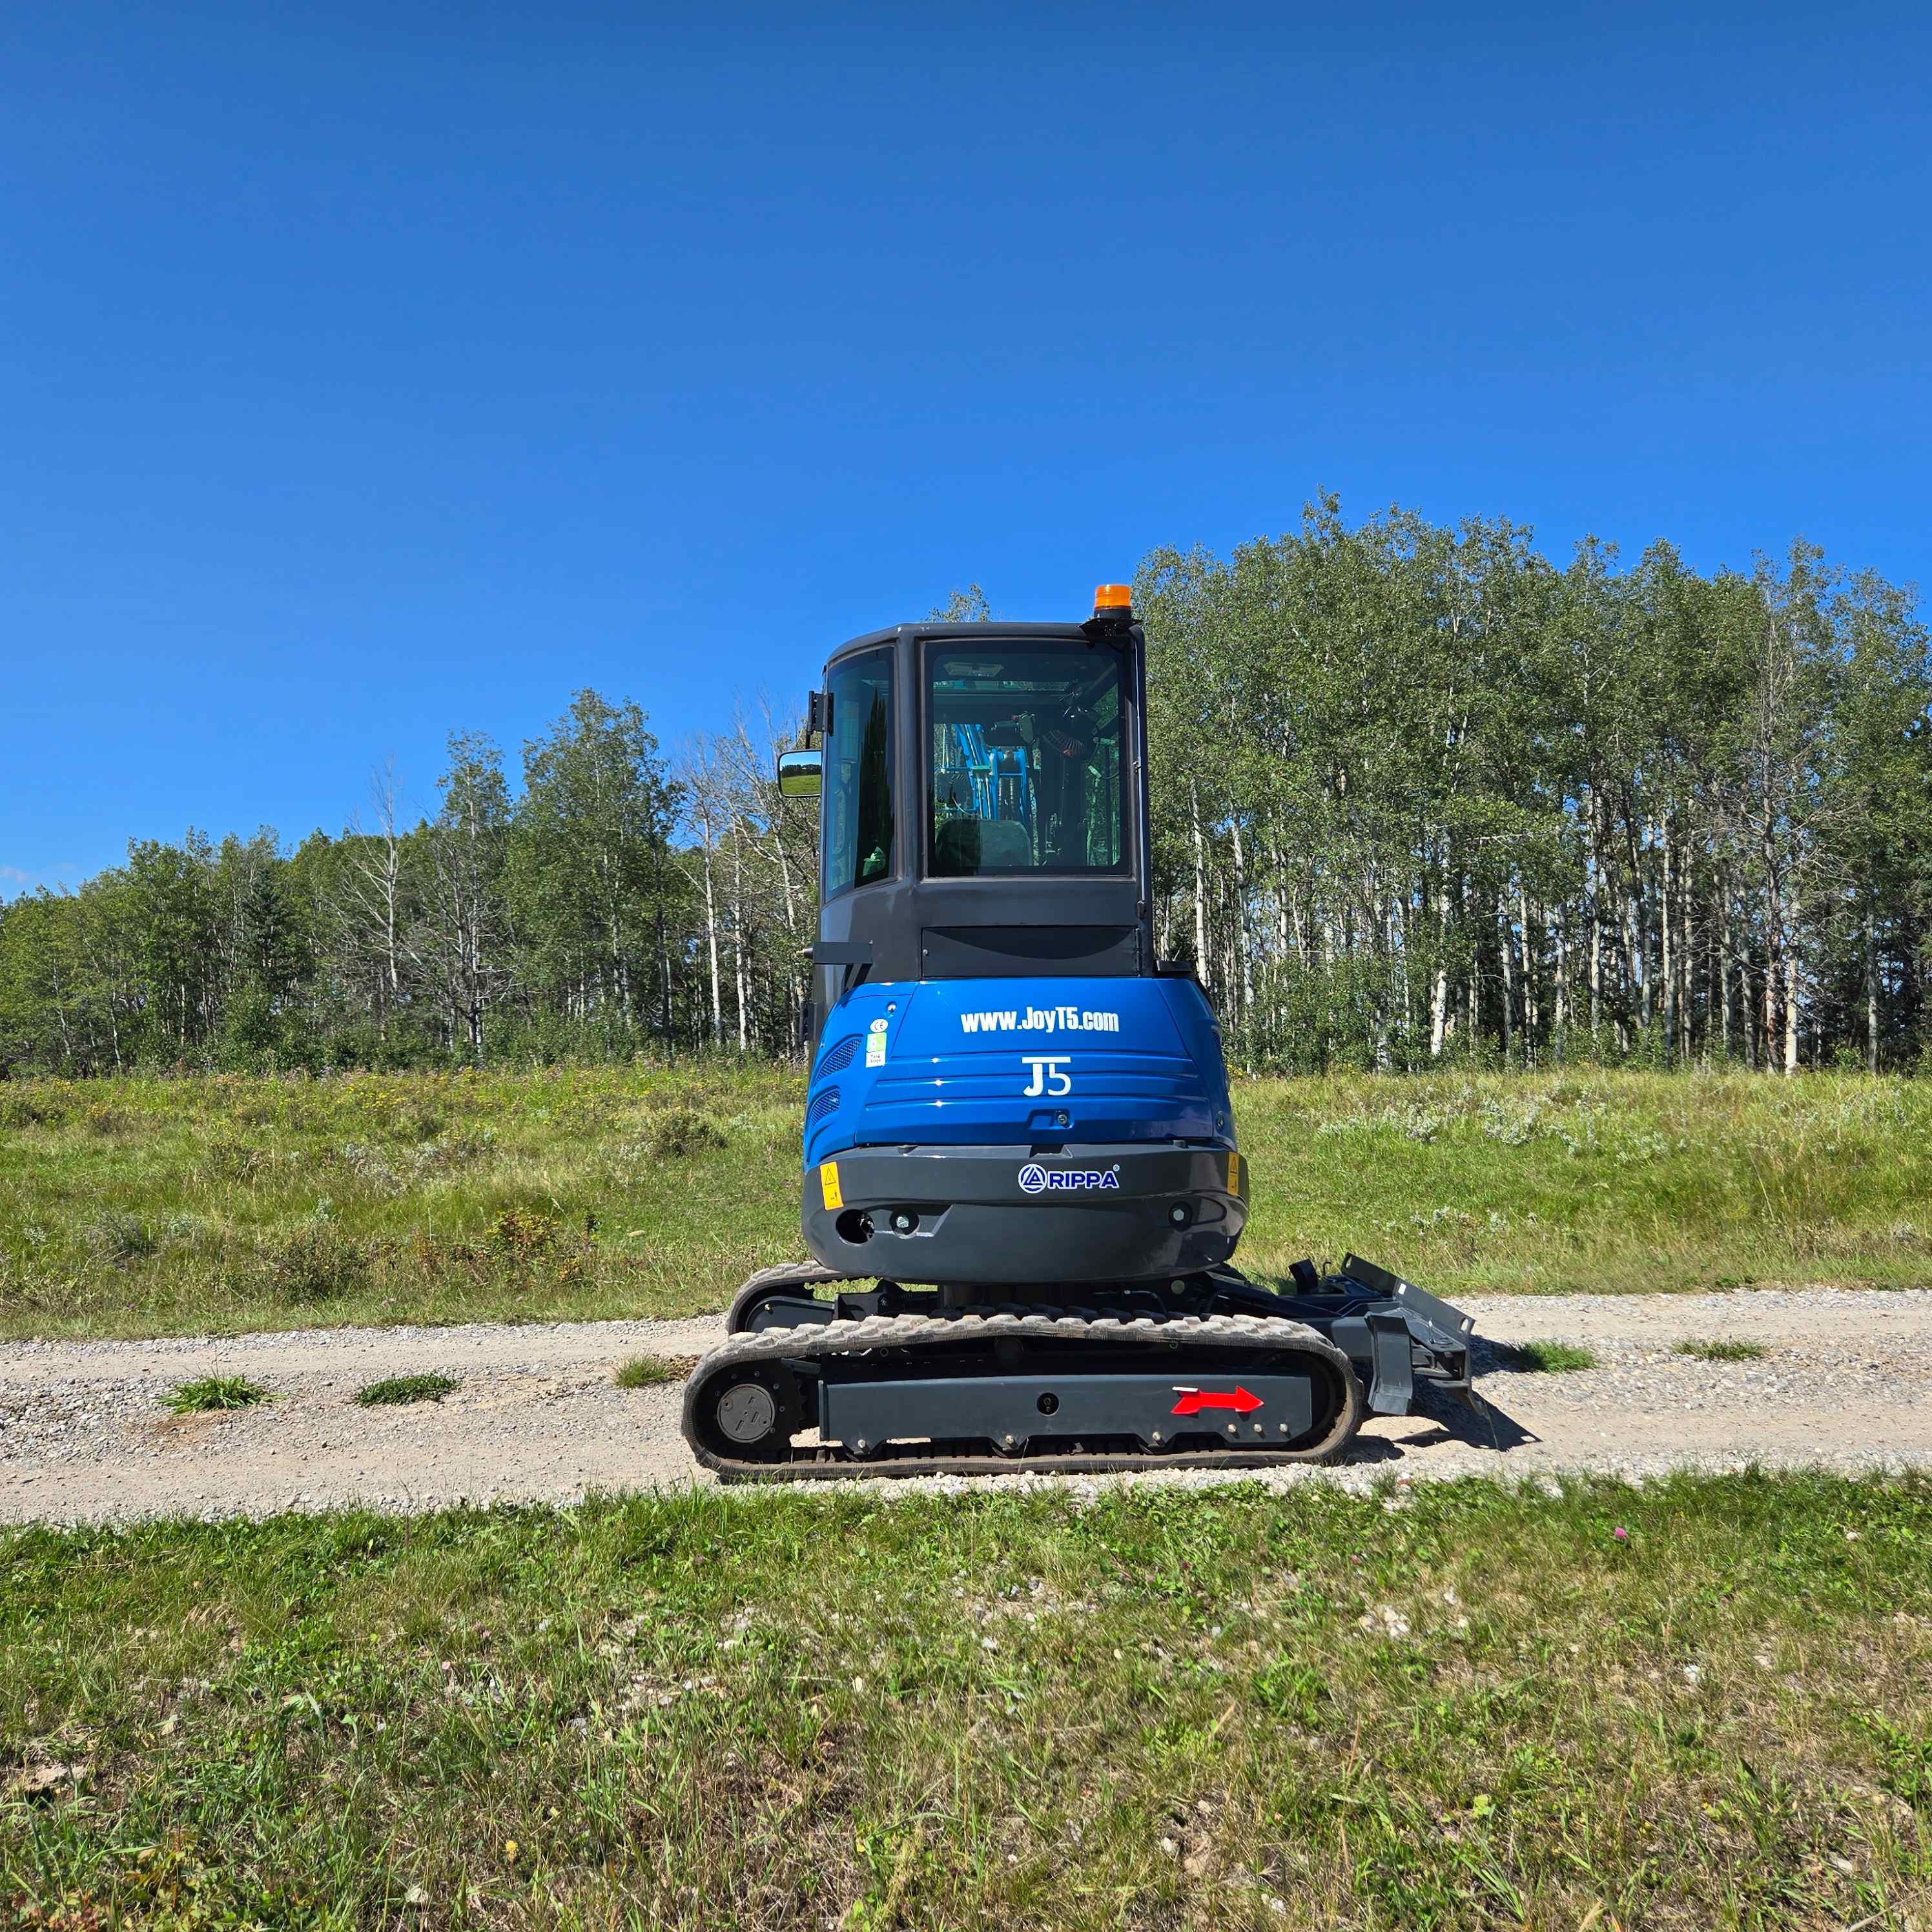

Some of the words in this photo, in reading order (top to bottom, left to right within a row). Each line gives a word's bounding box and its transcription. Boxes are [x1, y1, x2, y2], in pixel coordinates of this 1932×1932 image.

[960, 1007, 1120, 1033] www.JoyT5.com
[1022, 1056, 1072, 1096] J5
[1048, 1172, 1118, 1188] RIPPA
